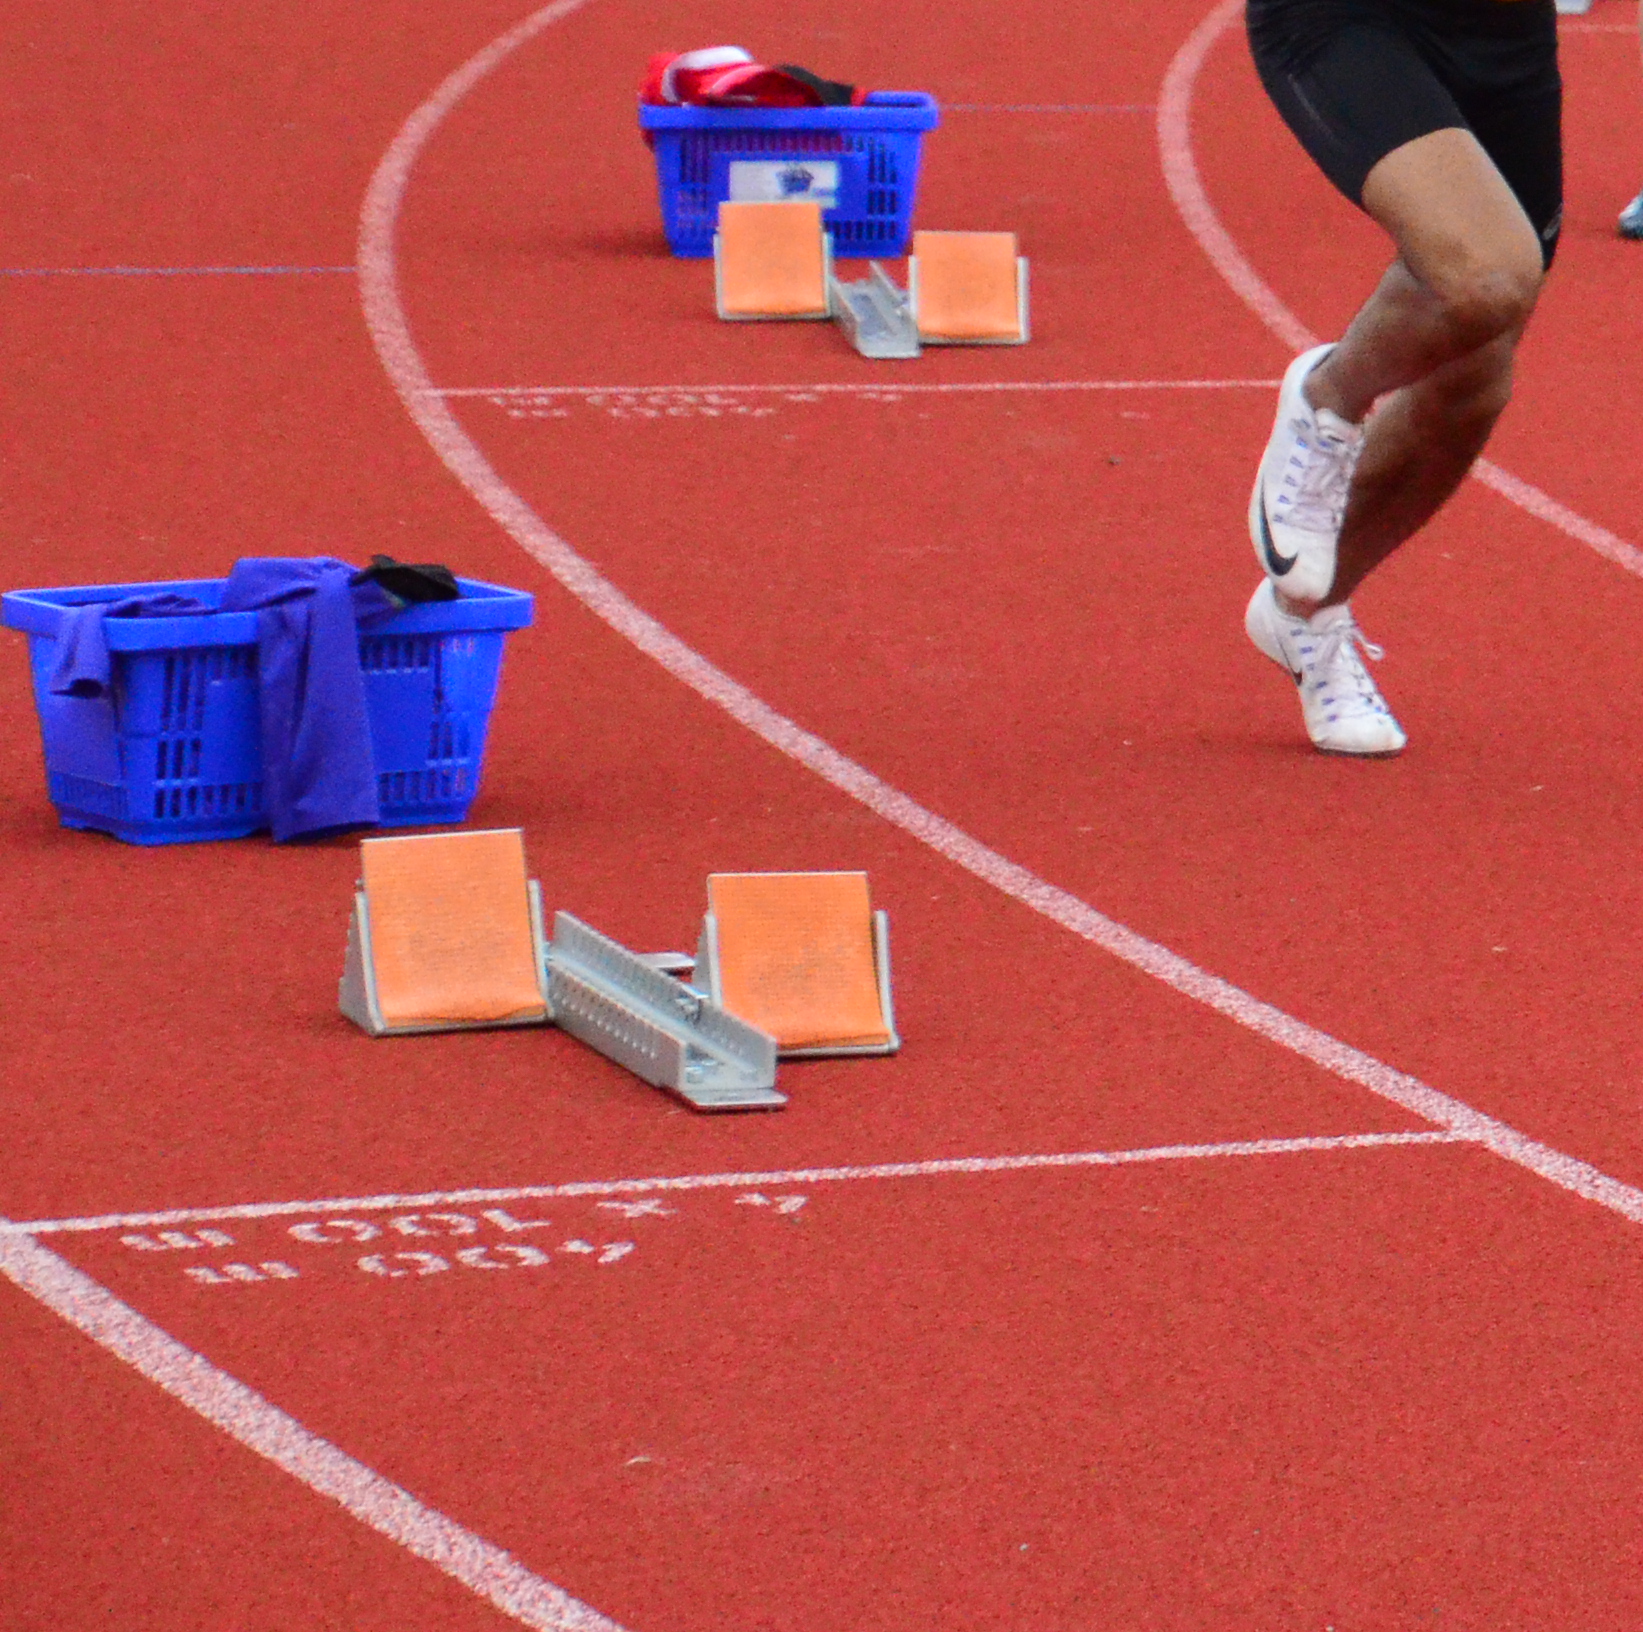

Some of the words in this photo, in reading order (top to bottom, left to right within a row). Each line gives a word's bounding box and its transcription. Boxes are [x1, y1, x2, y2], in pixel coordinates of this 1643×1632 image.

[119, 1228, 237, 1252] m
[286, 1208, 551, 1244] 100
[184, 1261, 299, 1284] m
[356, 1239, 636, 1277] 400
